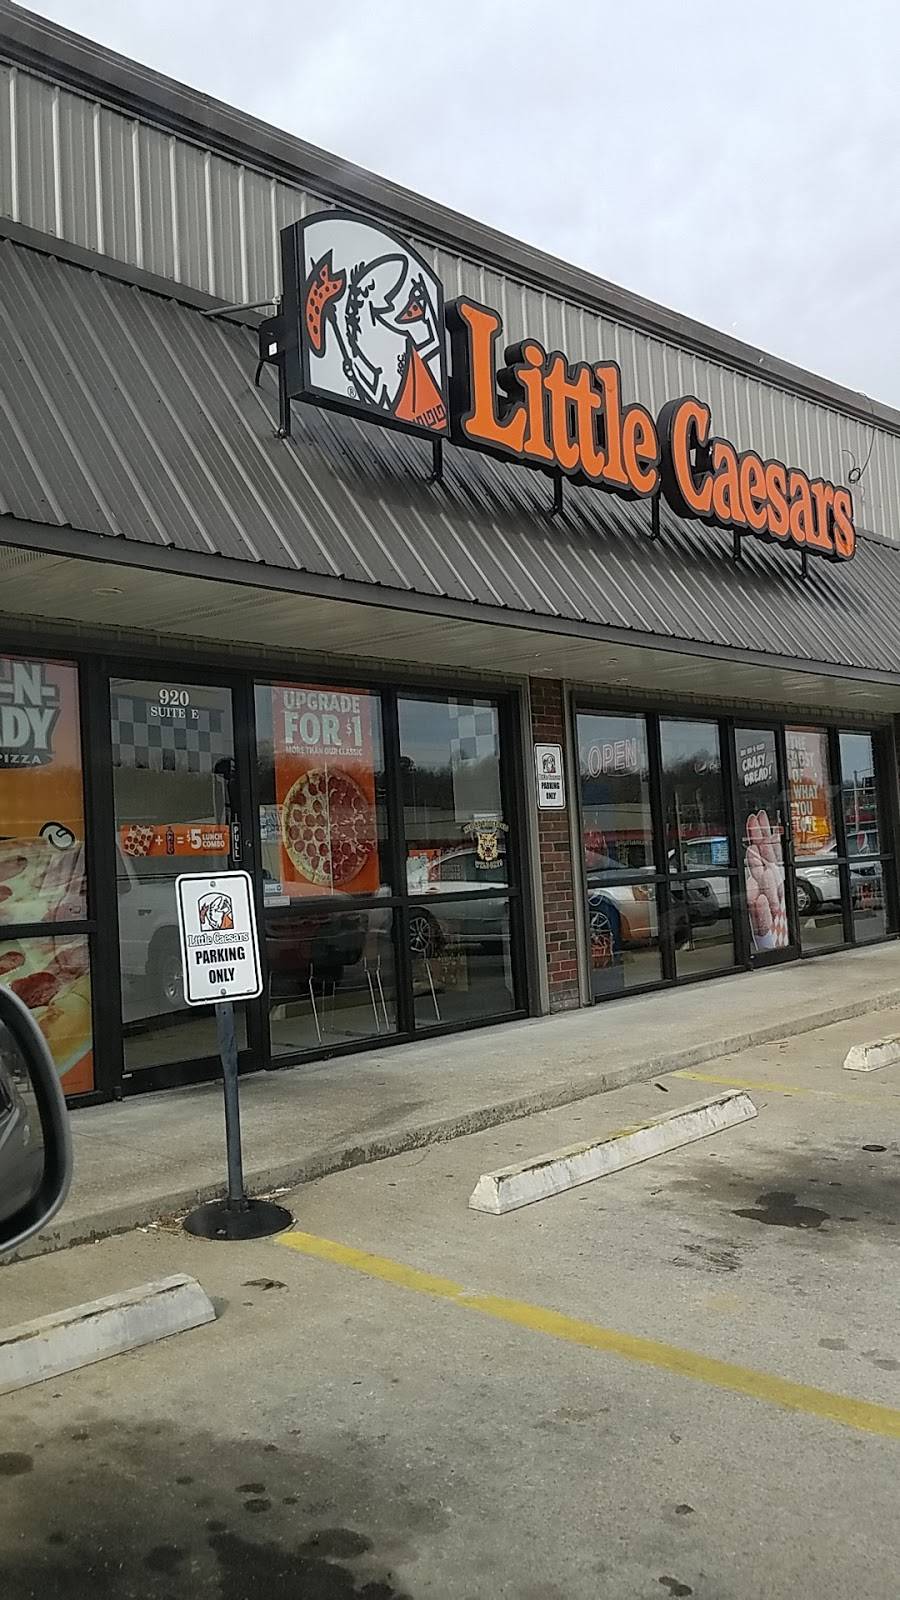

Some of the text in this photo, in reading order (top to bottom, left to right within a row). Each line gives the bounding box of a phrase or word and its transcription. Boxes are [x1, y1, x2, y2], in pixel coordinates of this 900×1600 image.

[461, 302, 855, 560] Little Caesars
[159, 688, 190, 706] 920
[283, 690, 361, 713] UPGRADE
[150, 706, 200, 719] SUITE E
[0, 706, 57, 750] DY
[285, 711, 363, 747] FOR $1
[587, 738, 637, 778] OPEN
[742, 753, 766, 772] CRAZY
[744, 765, 772, 787] BREAD!
[793, 784, 819, 799] WHAT
[794, 800, 813, 815] YOU
[202, 832, 224, 841] LUNCH
[202, 840, 226, 849] COMBO
[187, 931, 250, 948] Little Caesars
[195, 946, 246, 965] PARKING
[208, 968, 235, 984] ONLY
